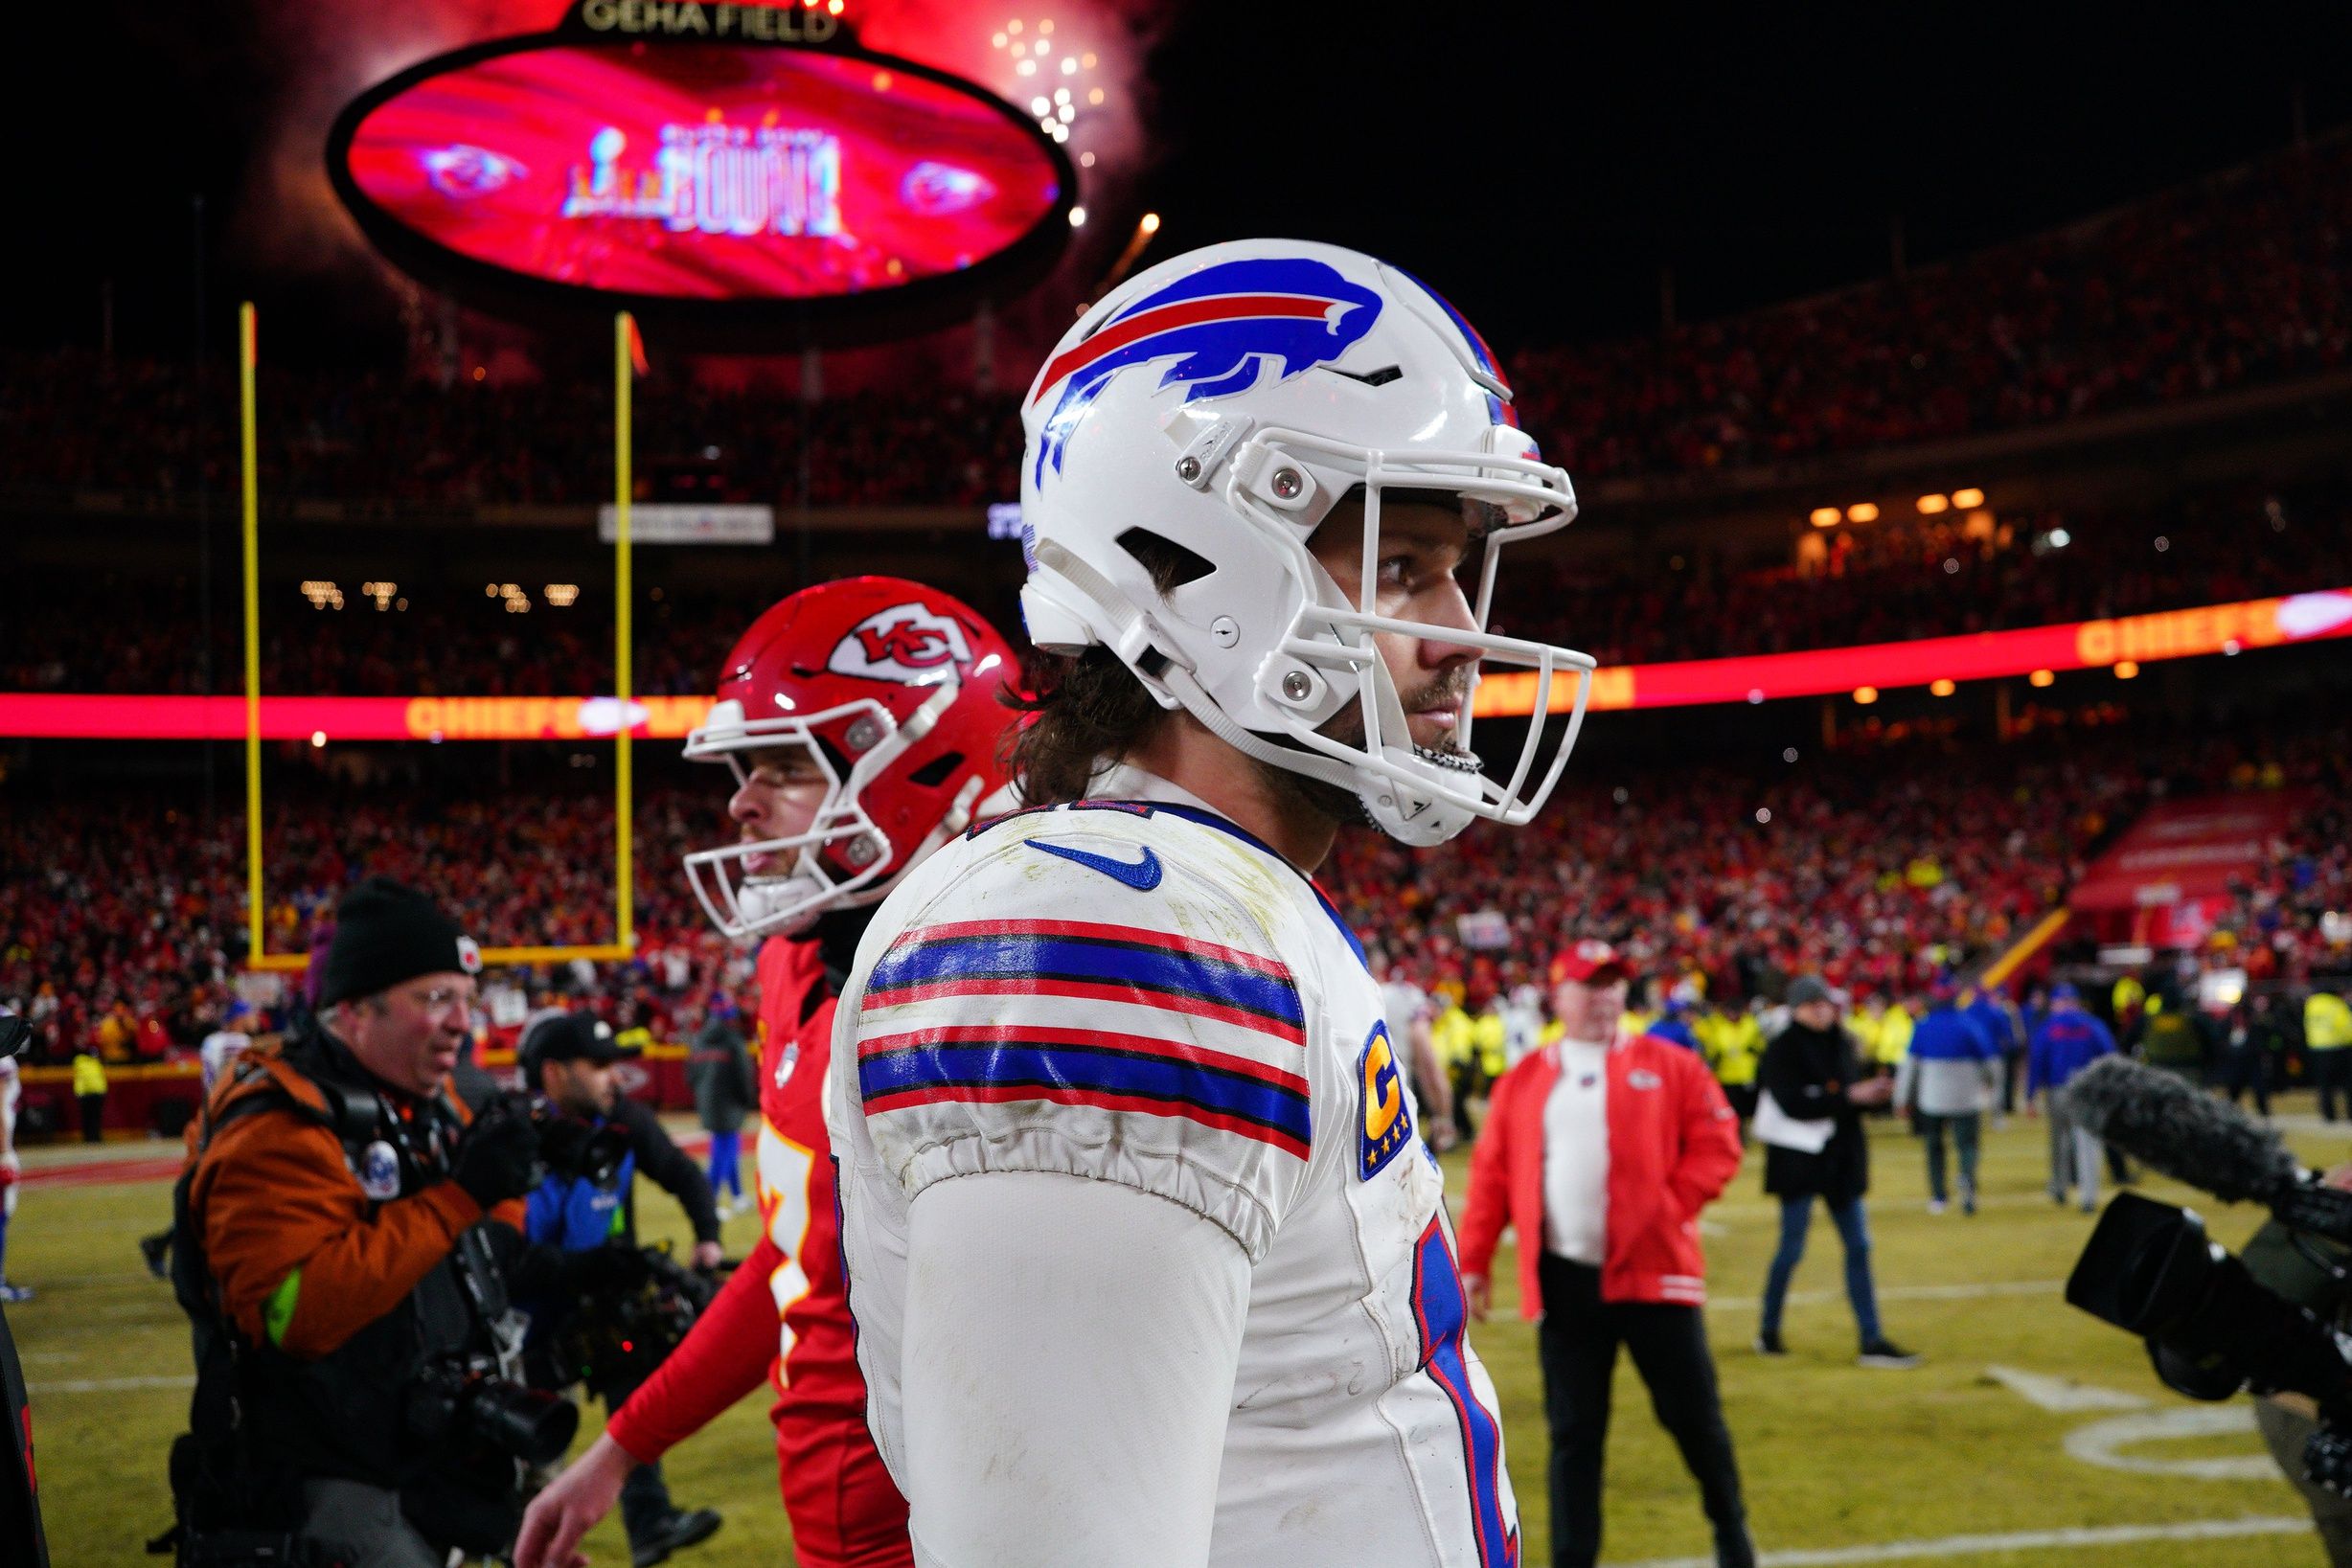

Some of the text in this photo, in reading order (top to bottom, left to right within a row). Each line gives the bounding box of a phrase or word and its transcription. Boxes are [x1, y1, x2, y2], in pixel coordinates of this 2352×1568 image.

[716, 4, 837, 43] FIELD
[2076, 596, 2282, 668] CHIEFS
[405, 696, 586, 739] CHIEFS
[1364, 1034, 1401, 1141] C
